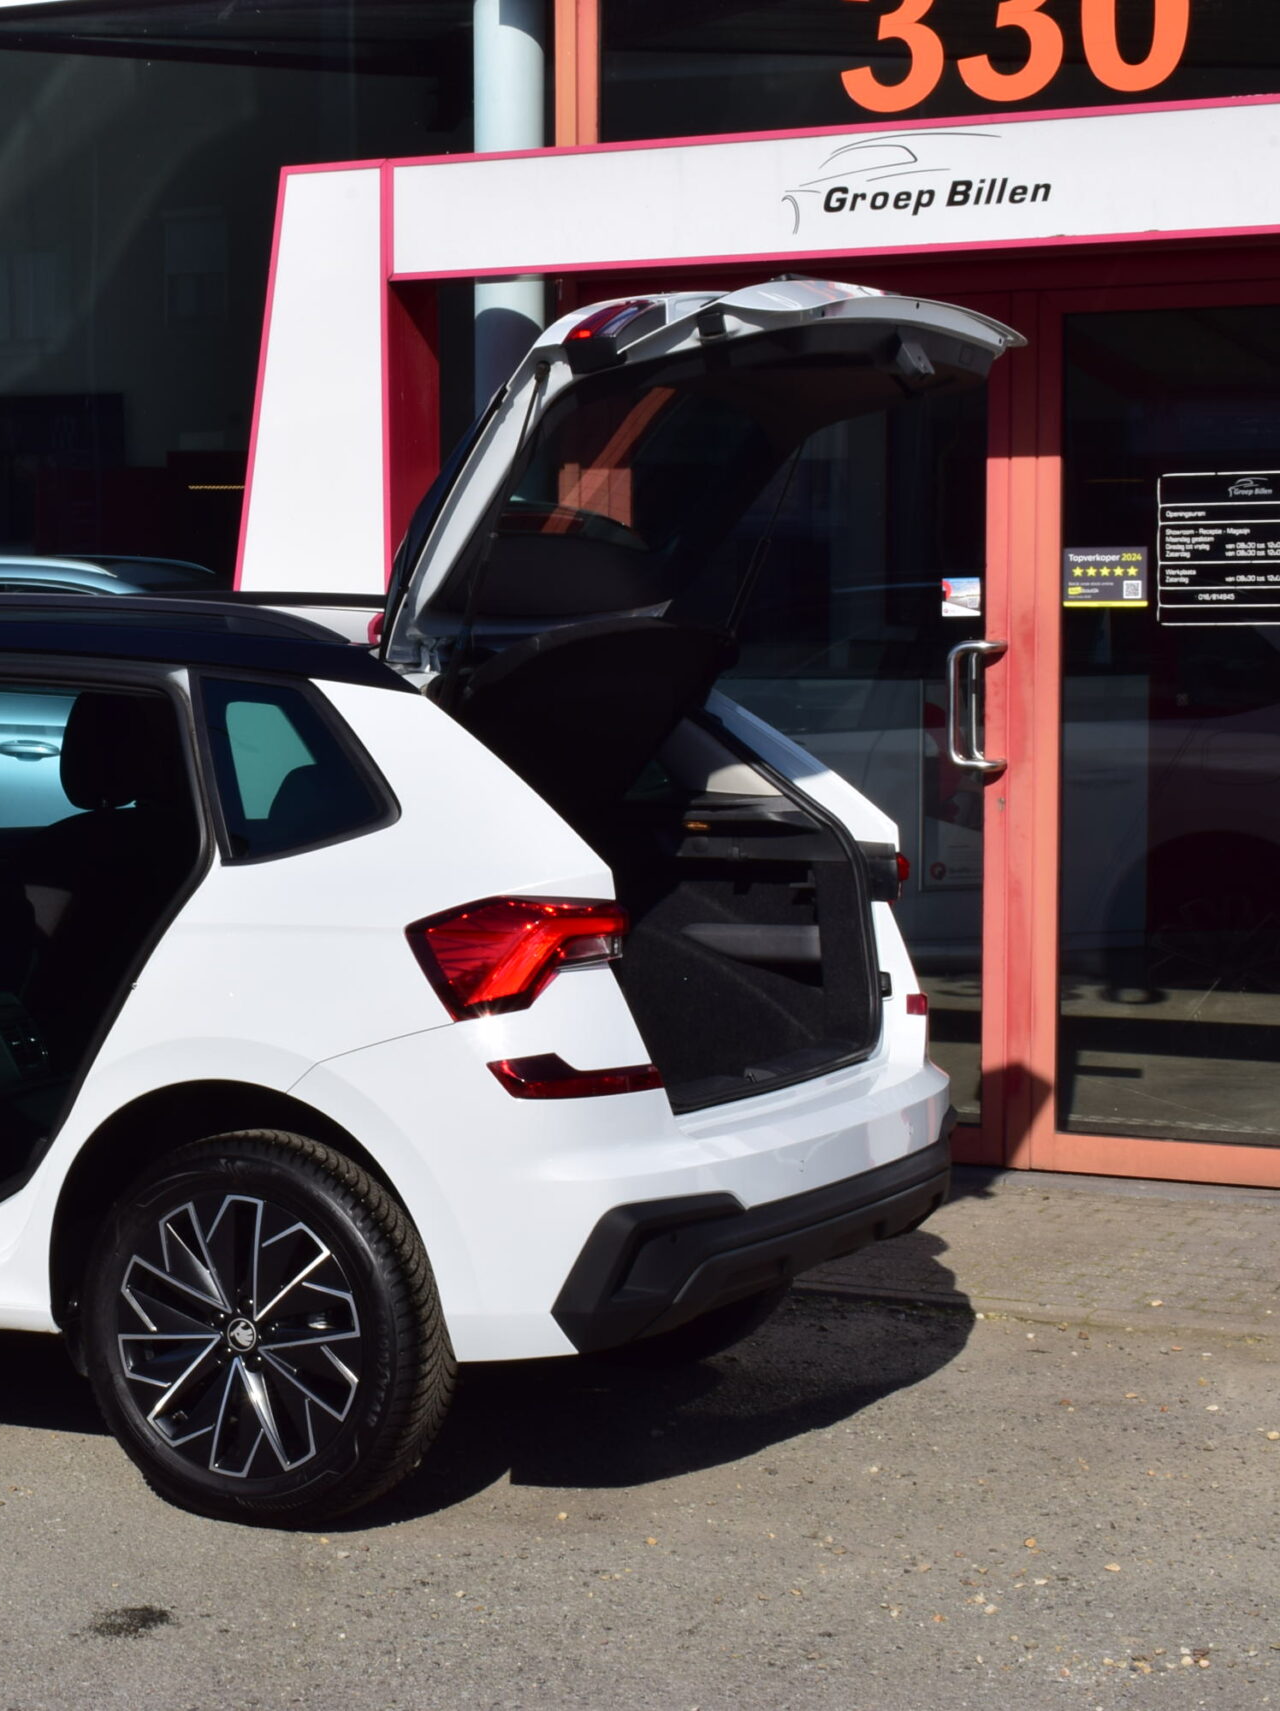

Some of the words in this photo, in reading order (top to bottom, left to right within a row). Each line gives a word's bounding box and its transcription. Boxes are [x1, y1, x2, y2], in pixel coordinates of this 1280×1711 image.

[823, 186, 936, 217] Groep
[945, 177, 1052, 207] Billen
[1233, 488, 1253, 496] Groep
[1068, 553, 1120, 563] Topverkoper
[1121, 552, 1142, 562] 2024
[367, 1305, 391, 1428] OODYEAR
